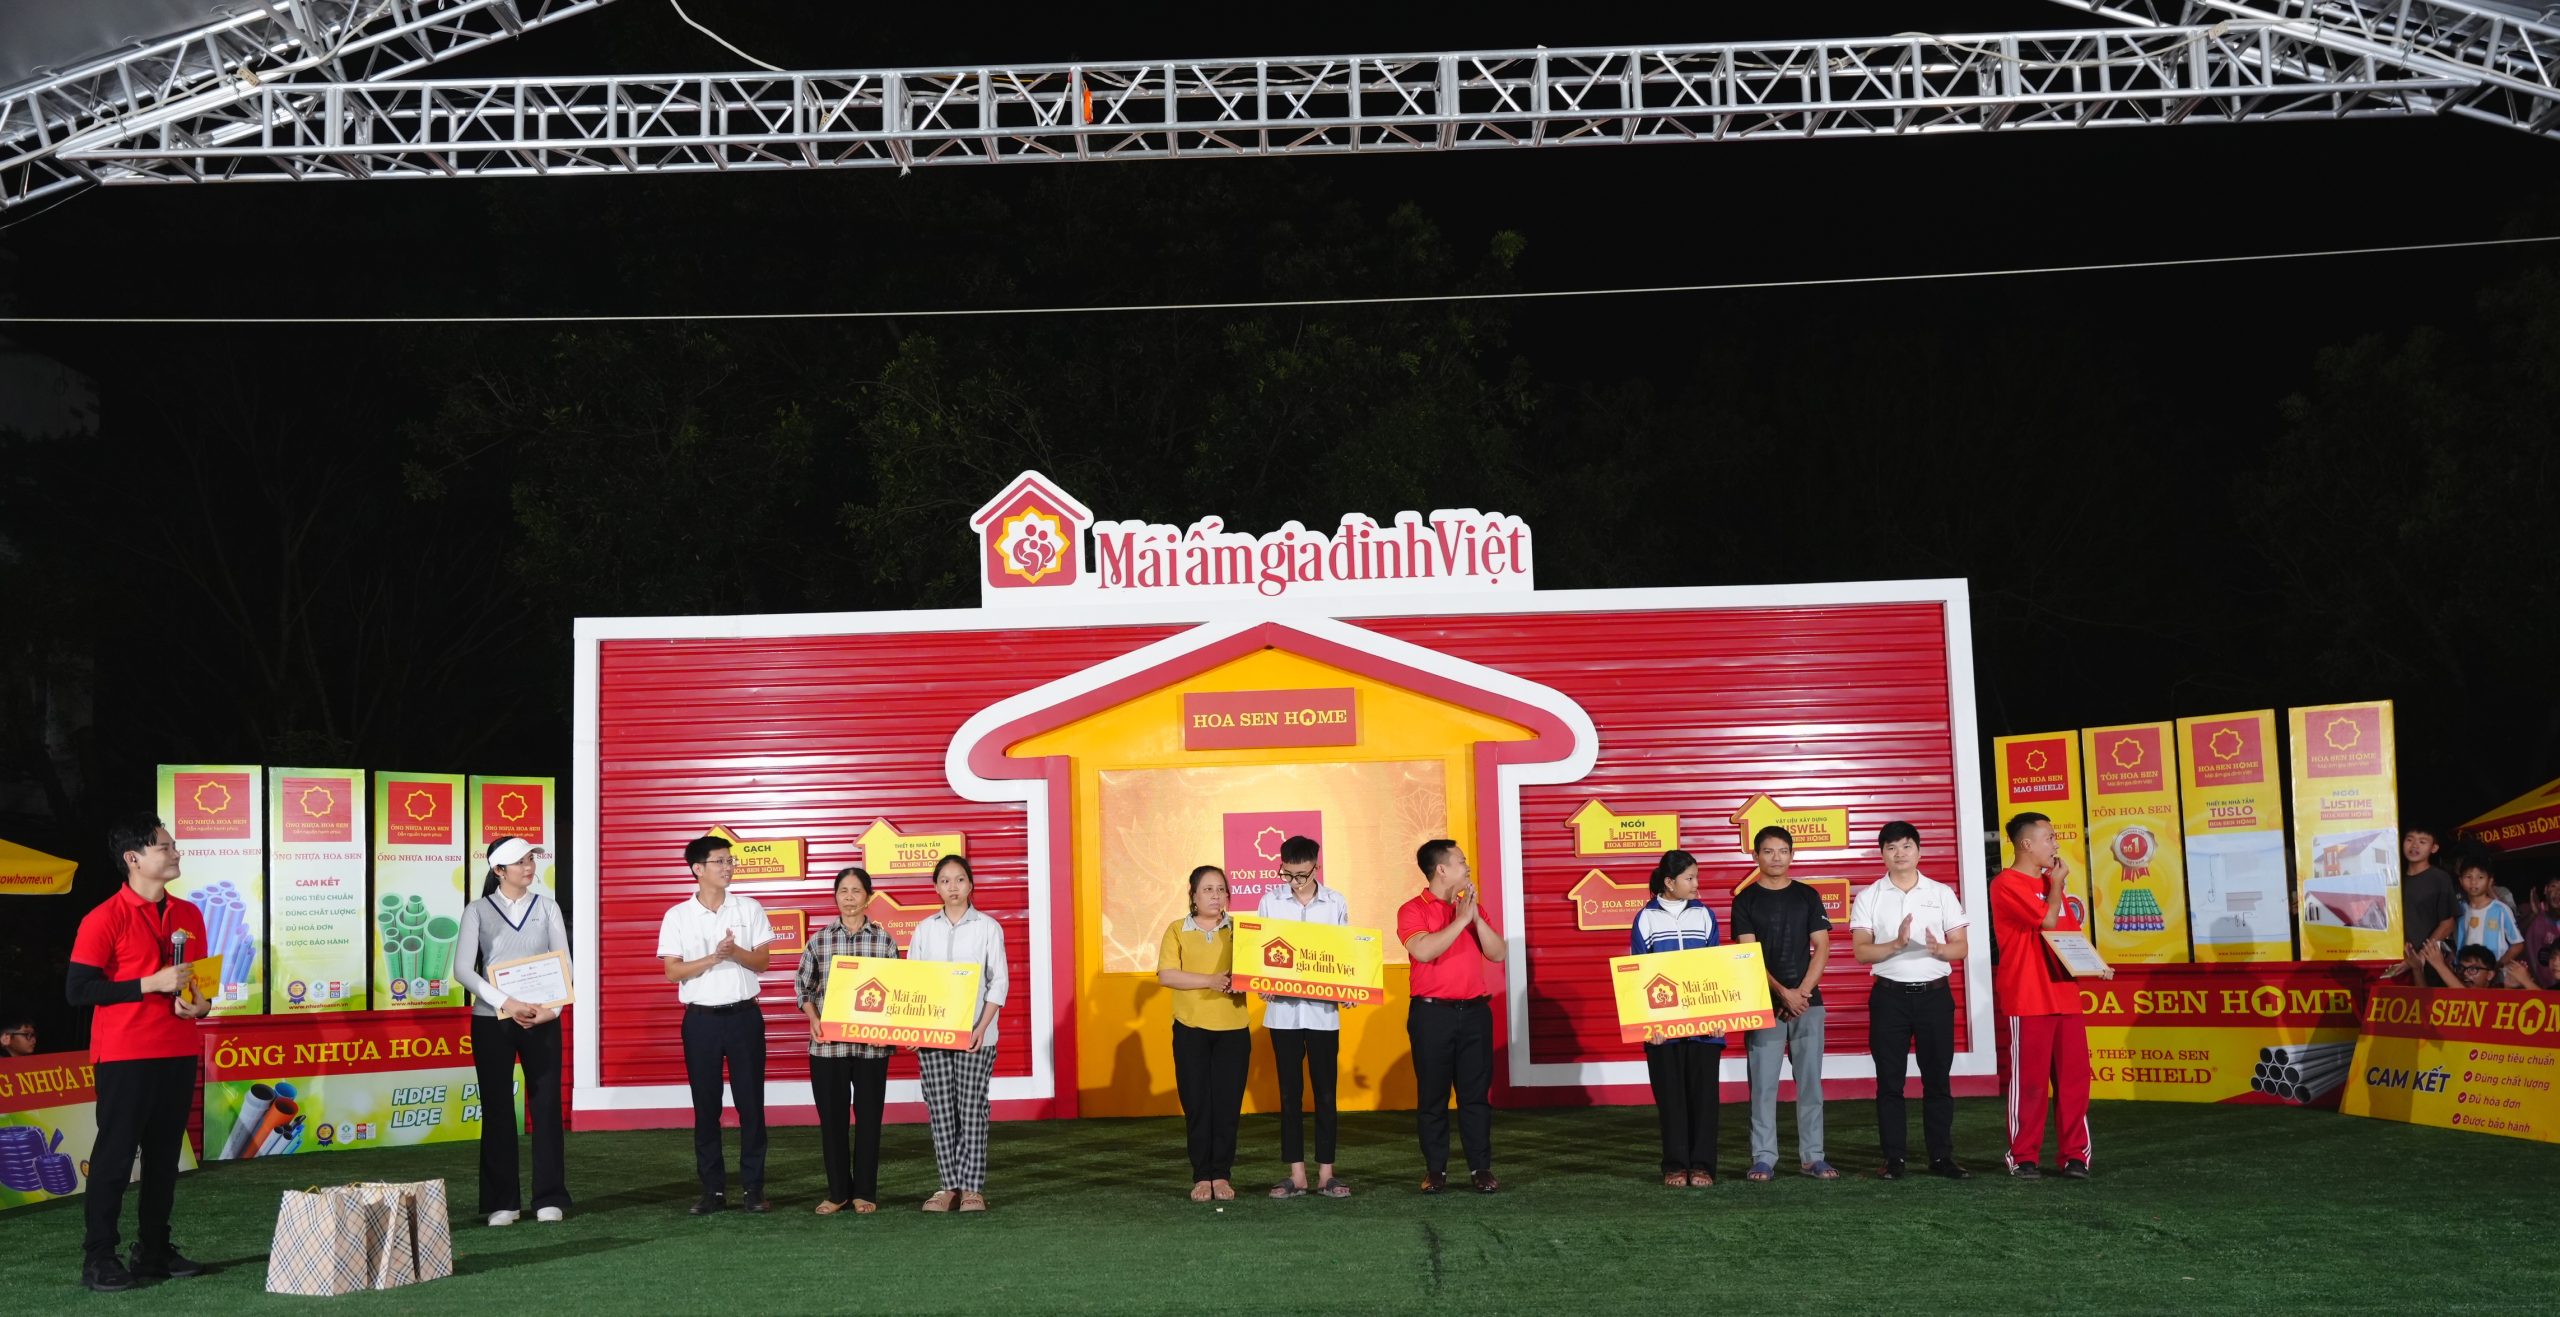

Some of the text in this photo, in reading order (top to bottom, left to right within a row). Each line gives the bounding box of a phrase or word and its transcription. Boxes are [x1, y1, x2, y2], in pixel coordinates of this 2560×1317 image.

[1430, 519, 1527, 585] Việt
[1193, 708, 1347, 728] HOA SEN HOME
[2311, 752, 2377, 763] HOA SEN HOME
[2198, 761, 2259, 773] HOA SEN HOME
[2047, 774, 2063, 782] SEN
[2101, 770, 2159, 781] TÔN HOA SEN
[2013, 783, 2064, 793] MAG SHIELD
[2320, 797, 2372, 810] LUSTIME
[2092, 805, 2172, 817] TÔN HOA SEN
[2210, 804, 2253, 818] TUSLO
[1620, 819, 1645, 828] NGÓI
[1609, 828, 1657, 840] LUSTIME
[2502, 823, 2526, 839] SEN
[188, 848, 216, 857] NHỰA
[219, 848, 240, 856] HOA
[242, 848, 262, 856] SEN
[294, 853, 321, 861] NHỰA
[377, 851, 397, 862] ỐNG
[398, 854, 423, 862] NHỰA
[536, 852, 553, 860] SEN
[897, 849, 939, 860] TUSLO
[0, 873, 54, 885] owhome.vn
[1231, 869, 1256, 880] TÔN
[296, 876, 341, 887] CAM KẾT
[1231, 884, 1262, 895] MAG
[1602, 899, 1644, 908] HOA SEN
[1300, 948, 1335, 963] Mái ấm
[1296, 960, 1355, 977] gia đình Việt
[1250, 977, 1370, 1001] 60.000.000 VNĐ
[1682, 978, 1719, 994] Mái ấm
[892, 988, 927, 1003] Mái ấm
[1681, 988, 1742, 1009] gia đình Việt
[2080, 985, 2352, 1018] OA SEN HOME
[886, 1003, 946, 1018] gia đình Việt
[2367, 997, 2489, 1028] HOA SEN
[1728, 1015, 1764, 1030] VNĐ
[840, 1023, 956, 1045] 19.000.000 VNĐ
[214, 1036, 286, 1069] ỐNG
[294, 1039, 381, 1067] NHỰA
[389, 1036, 452, 1059] HOA
[2096, 1047, 2136, 1060] THÉP
[2141, 1049, 2175, 1061] HOA
[2178, 1049, 2210, 1061] SEN
[2507, 1053, 2525, 1063] tiêu
[15, 1065, 79, 1098] NHỰA
[2122, 1067, 2212, 1085] SHIELD
[2366, 1066, 2451, 1093] CAM KẾT
[2501, 1074, 2522, 1087] chất
[392, 1085, 448, 1106] HDPE
[2502, 1098, 2521, 1109] đơn
[391, 1107, 443, 1128] LDPE
